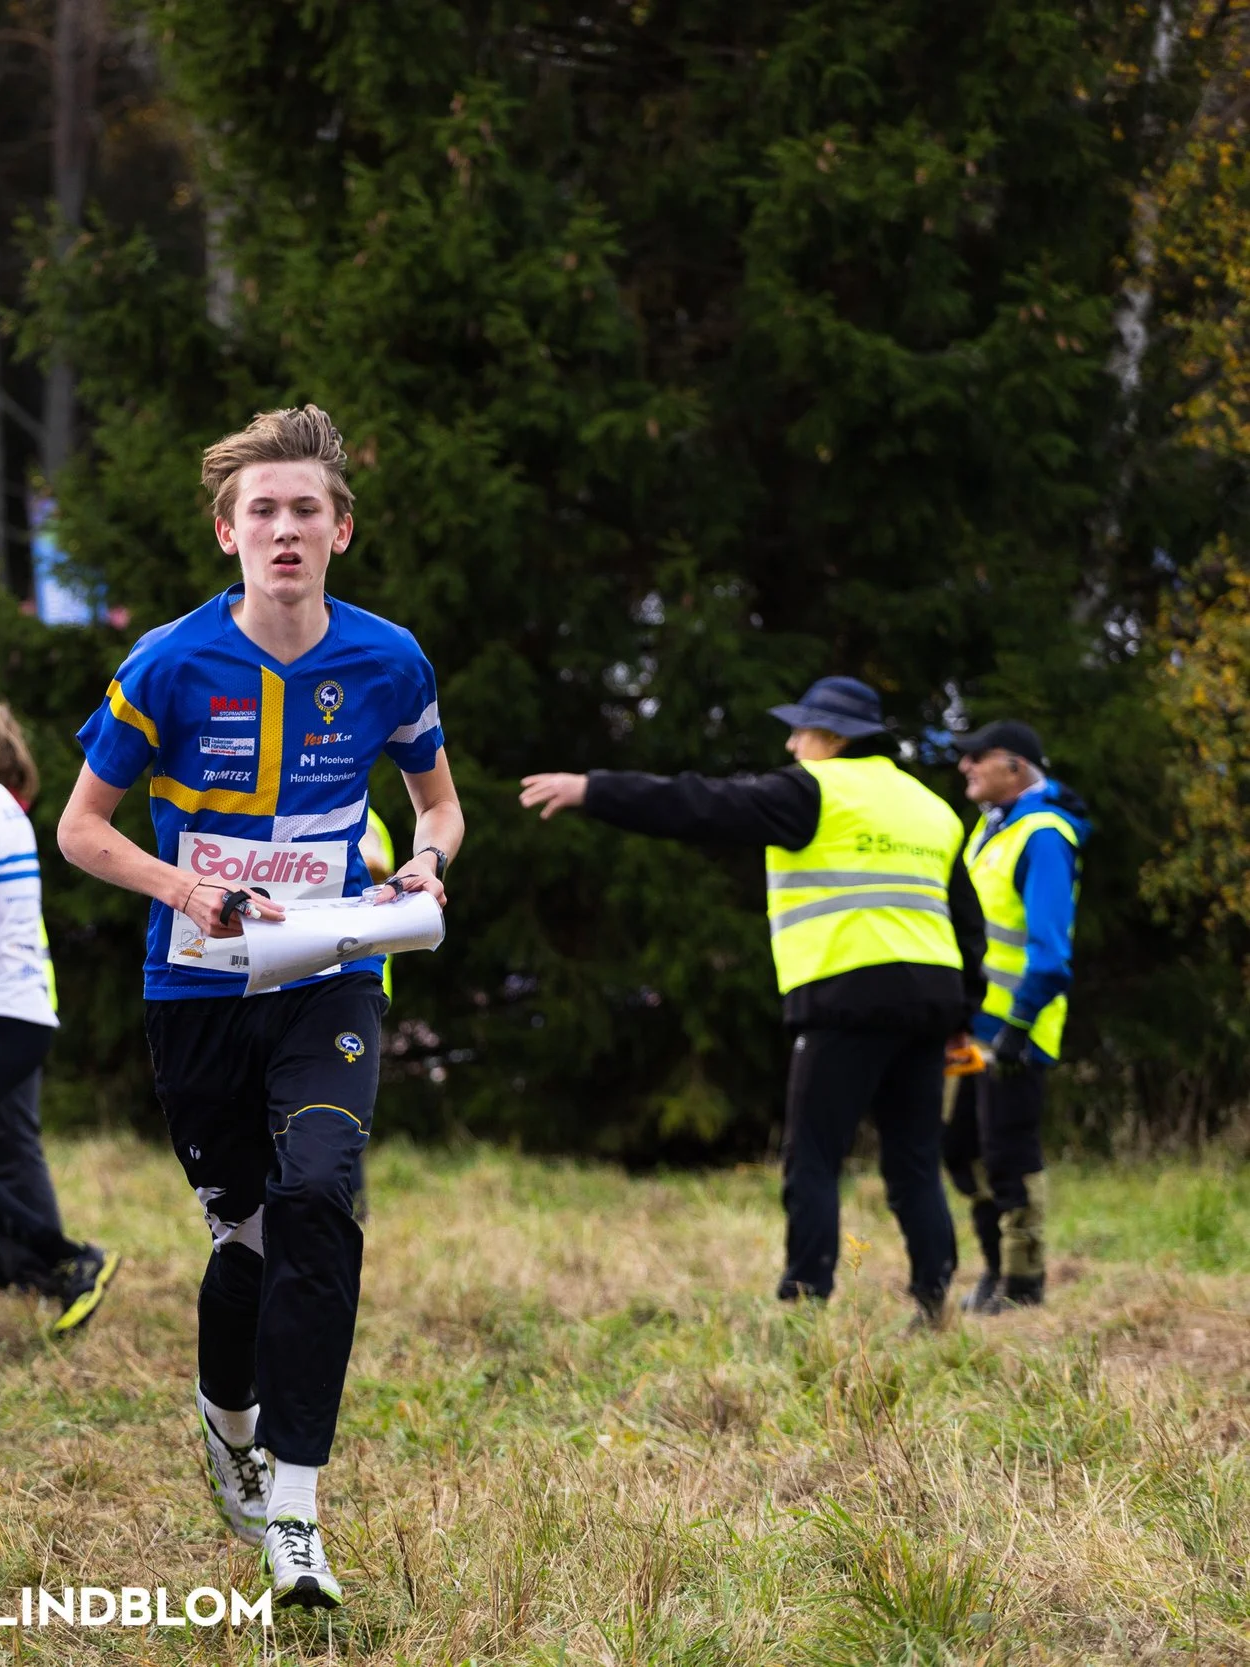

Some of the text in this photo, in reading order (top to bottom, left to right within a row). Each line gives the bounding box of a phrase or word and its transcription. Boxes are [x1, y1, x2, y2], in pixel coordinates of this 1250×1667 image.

[320, 756, 354, 764] Moelven
[203, 769, 252, 782] TRIMTEX
[290, 772, 356, 783] Handelsbanken
[190, 838, 329, 885] Goldlife
